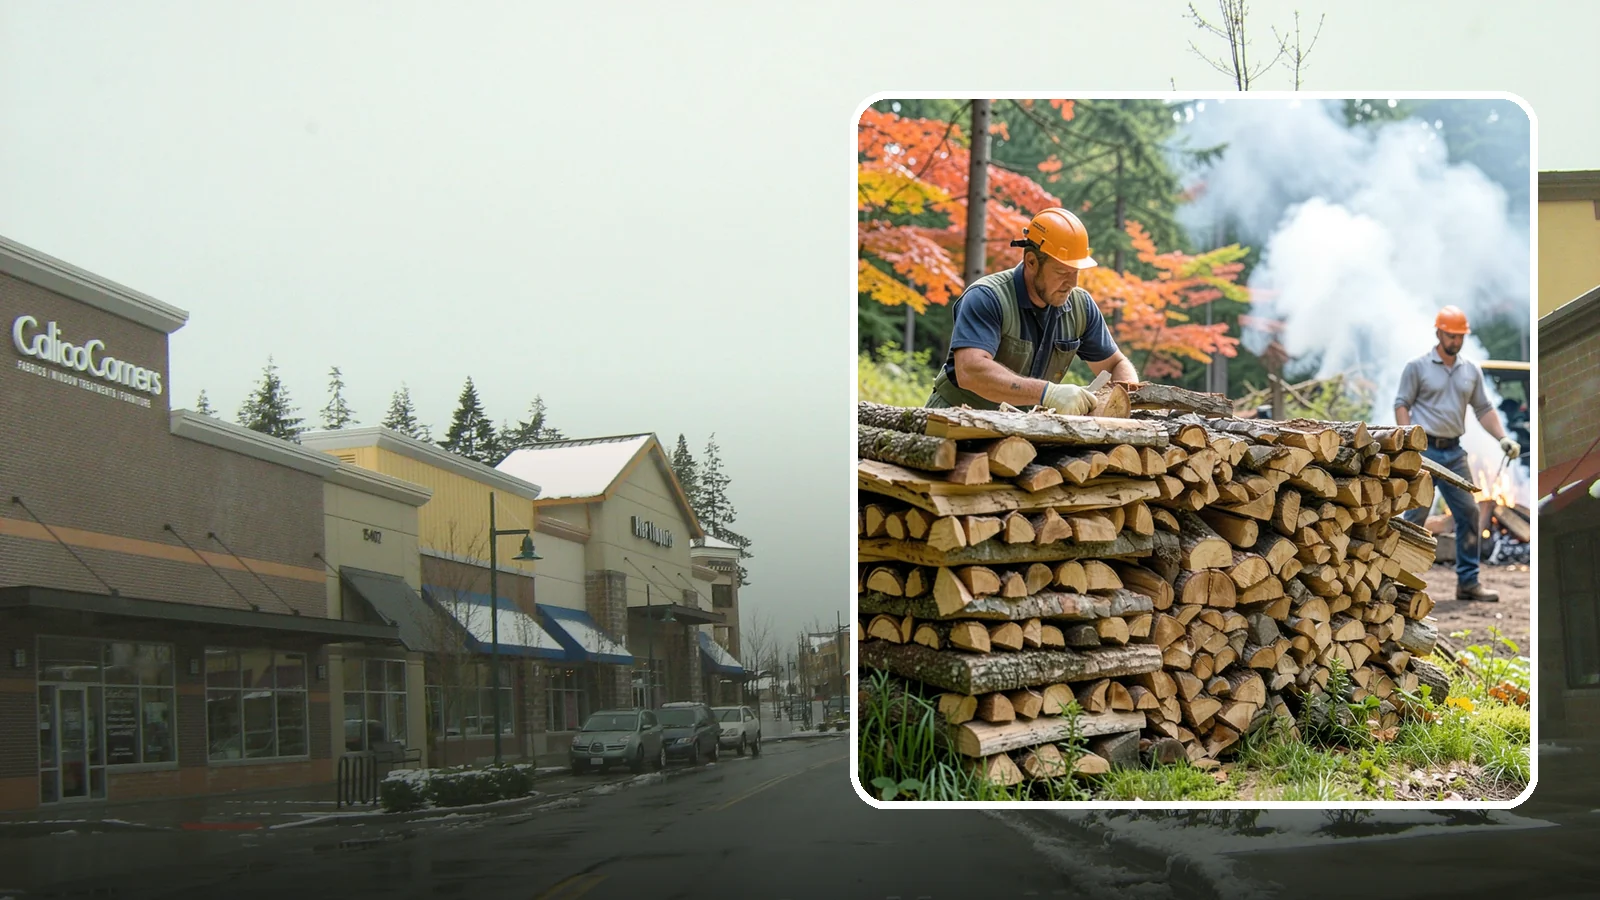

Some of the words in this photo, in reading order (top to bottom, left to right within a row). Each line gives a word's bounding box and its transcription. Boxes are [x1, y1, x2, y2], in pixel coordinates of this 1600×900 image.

[17, 360, 47, 377] FABRICS
[51, 370, 78, 386] WINDOW
[79, 378, 116, 398] TREATMENTS
[120, 391, 151, 408] FURNITURE
